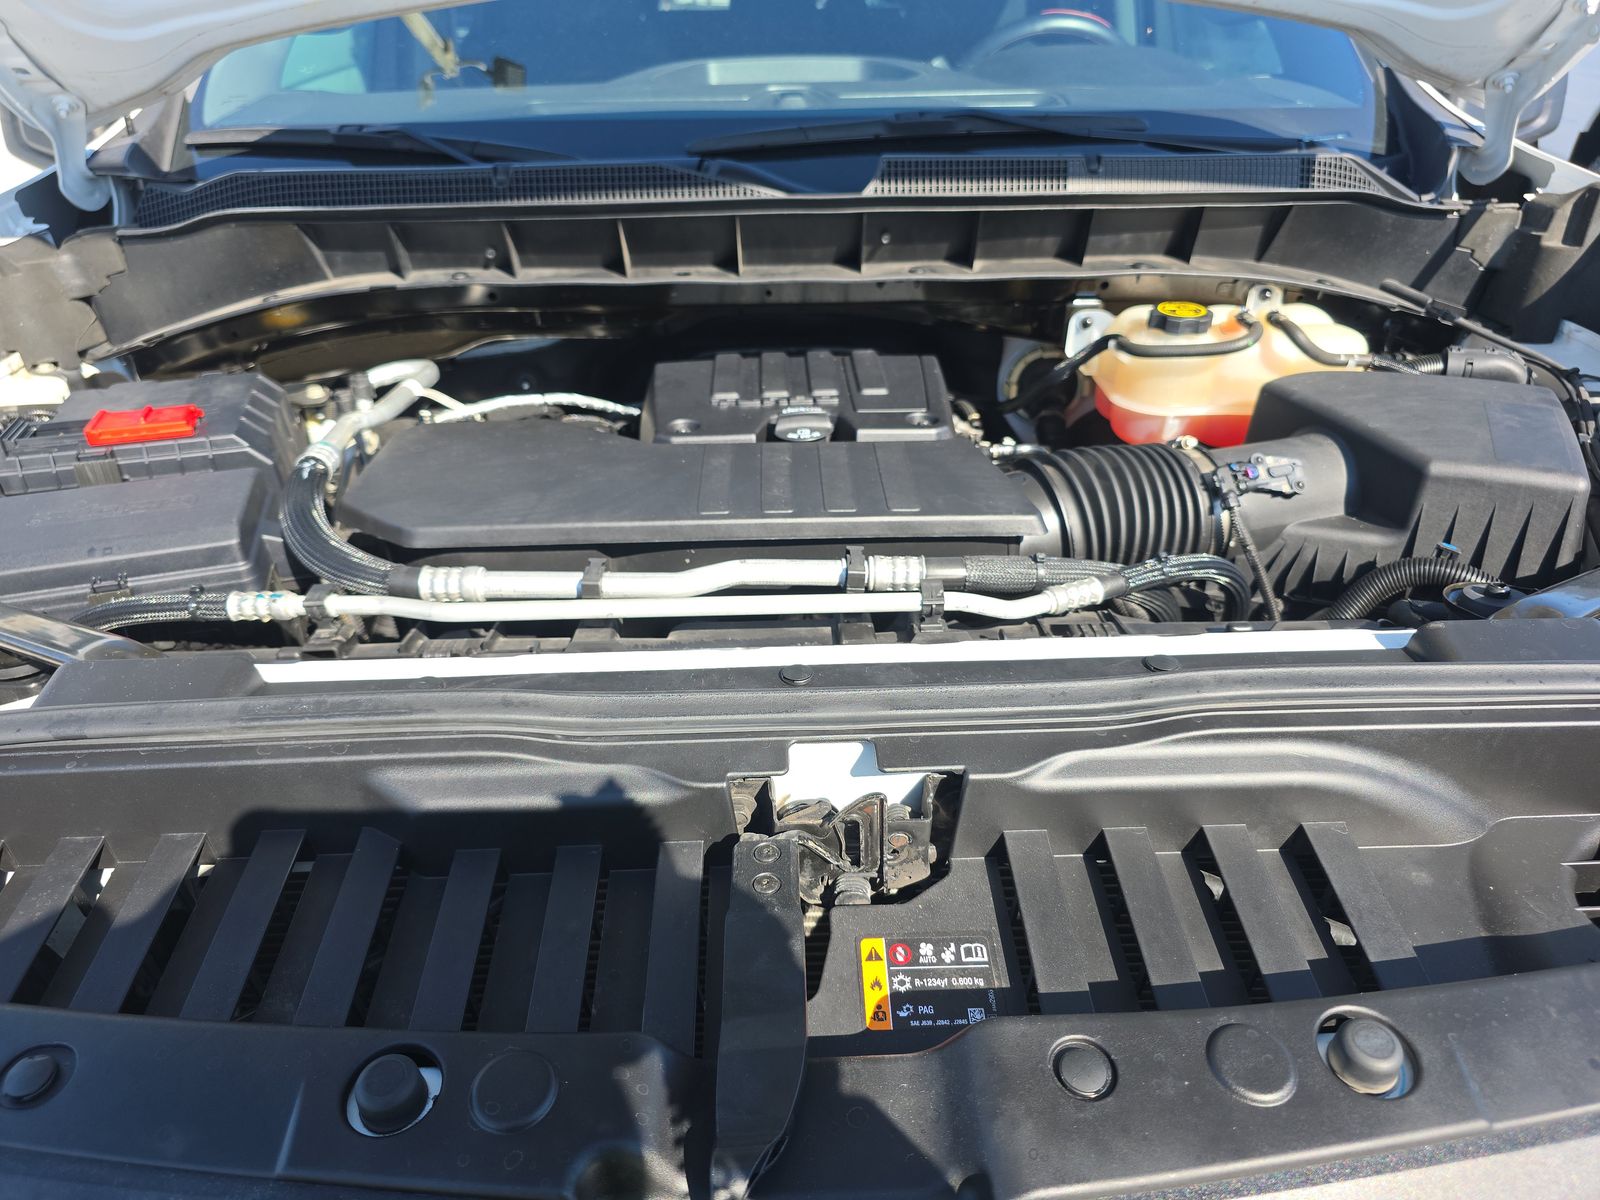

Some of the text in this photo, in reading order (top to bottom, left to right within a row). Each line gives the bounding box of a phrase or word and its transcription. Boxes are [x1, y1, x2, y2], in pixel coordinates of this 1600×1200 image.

[919, 956, 937, 964] AUTO
[914, 977, 948, 988] R-1234yf
[974, 976, 985, 987] kg
[918, 1005, 934, 1015] PAG
